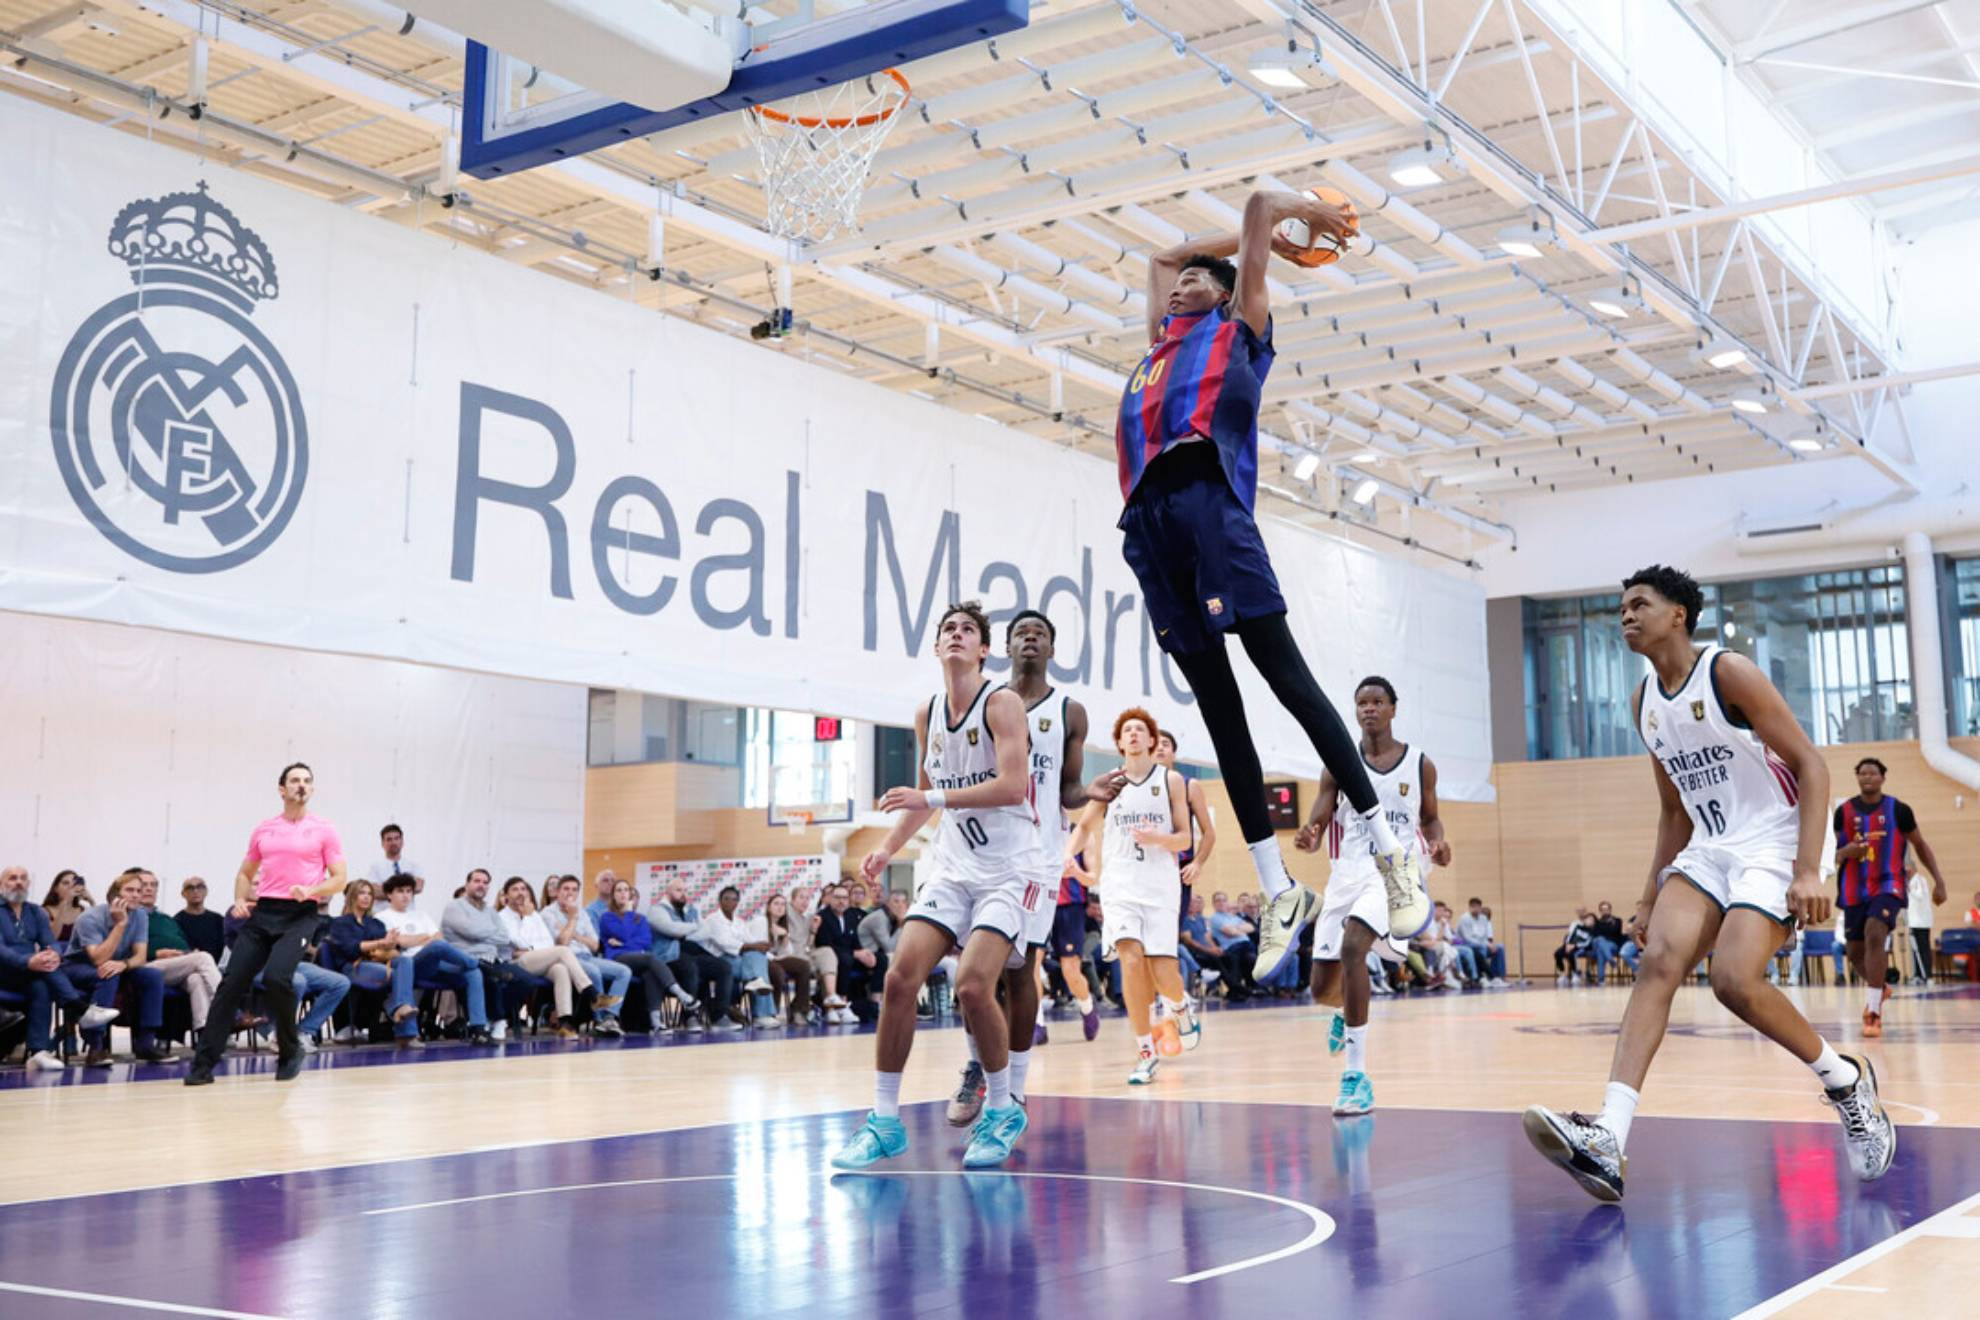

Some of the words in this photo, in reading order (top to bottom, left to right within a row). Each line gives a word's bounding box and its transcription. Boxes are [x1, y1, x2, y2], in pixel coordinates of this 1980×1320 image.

[1130, 358, 1166, 394] 60
[450, 380, 801, 640] Real
[956, 816, 989, 850] 10
[1696, 799, 1726, 837] 16
[1134, 842, 1145, 862] 5
